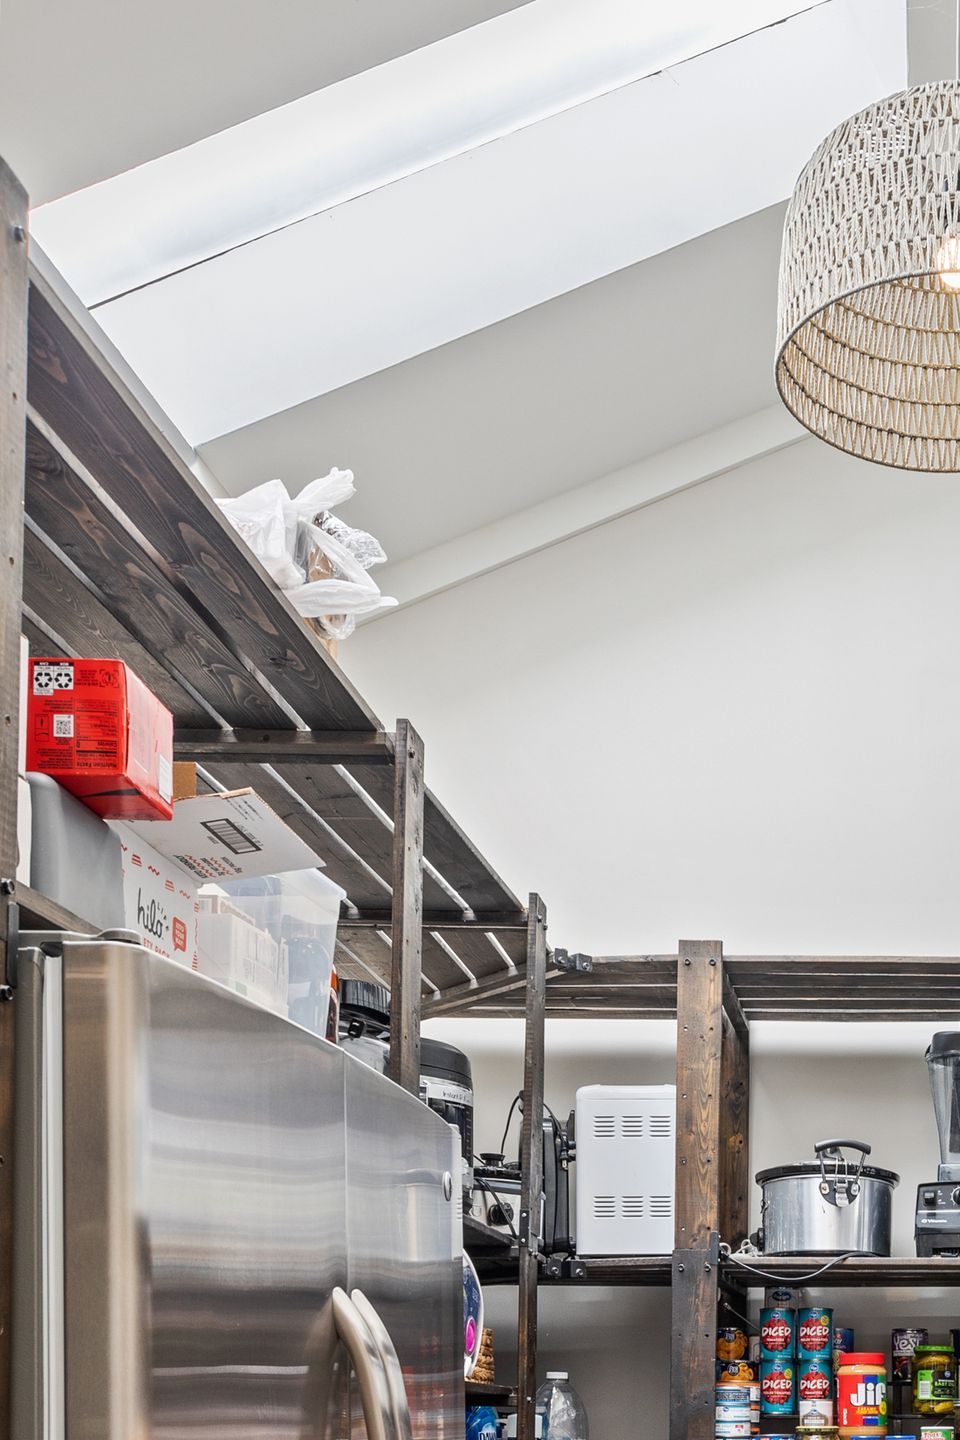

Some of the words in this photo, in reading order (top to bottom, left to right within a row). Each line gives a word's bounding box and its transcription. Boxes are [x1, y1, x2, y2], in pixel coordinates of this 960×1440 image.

[761, 1326, 792, 1337] DICED
[800, 1326, 830, 1336] DICED
[762, 1379, 793, 1389] DICED
[800, 1379, 830, 1389] DICED
[850, 1383, 886, 1407] Jif
